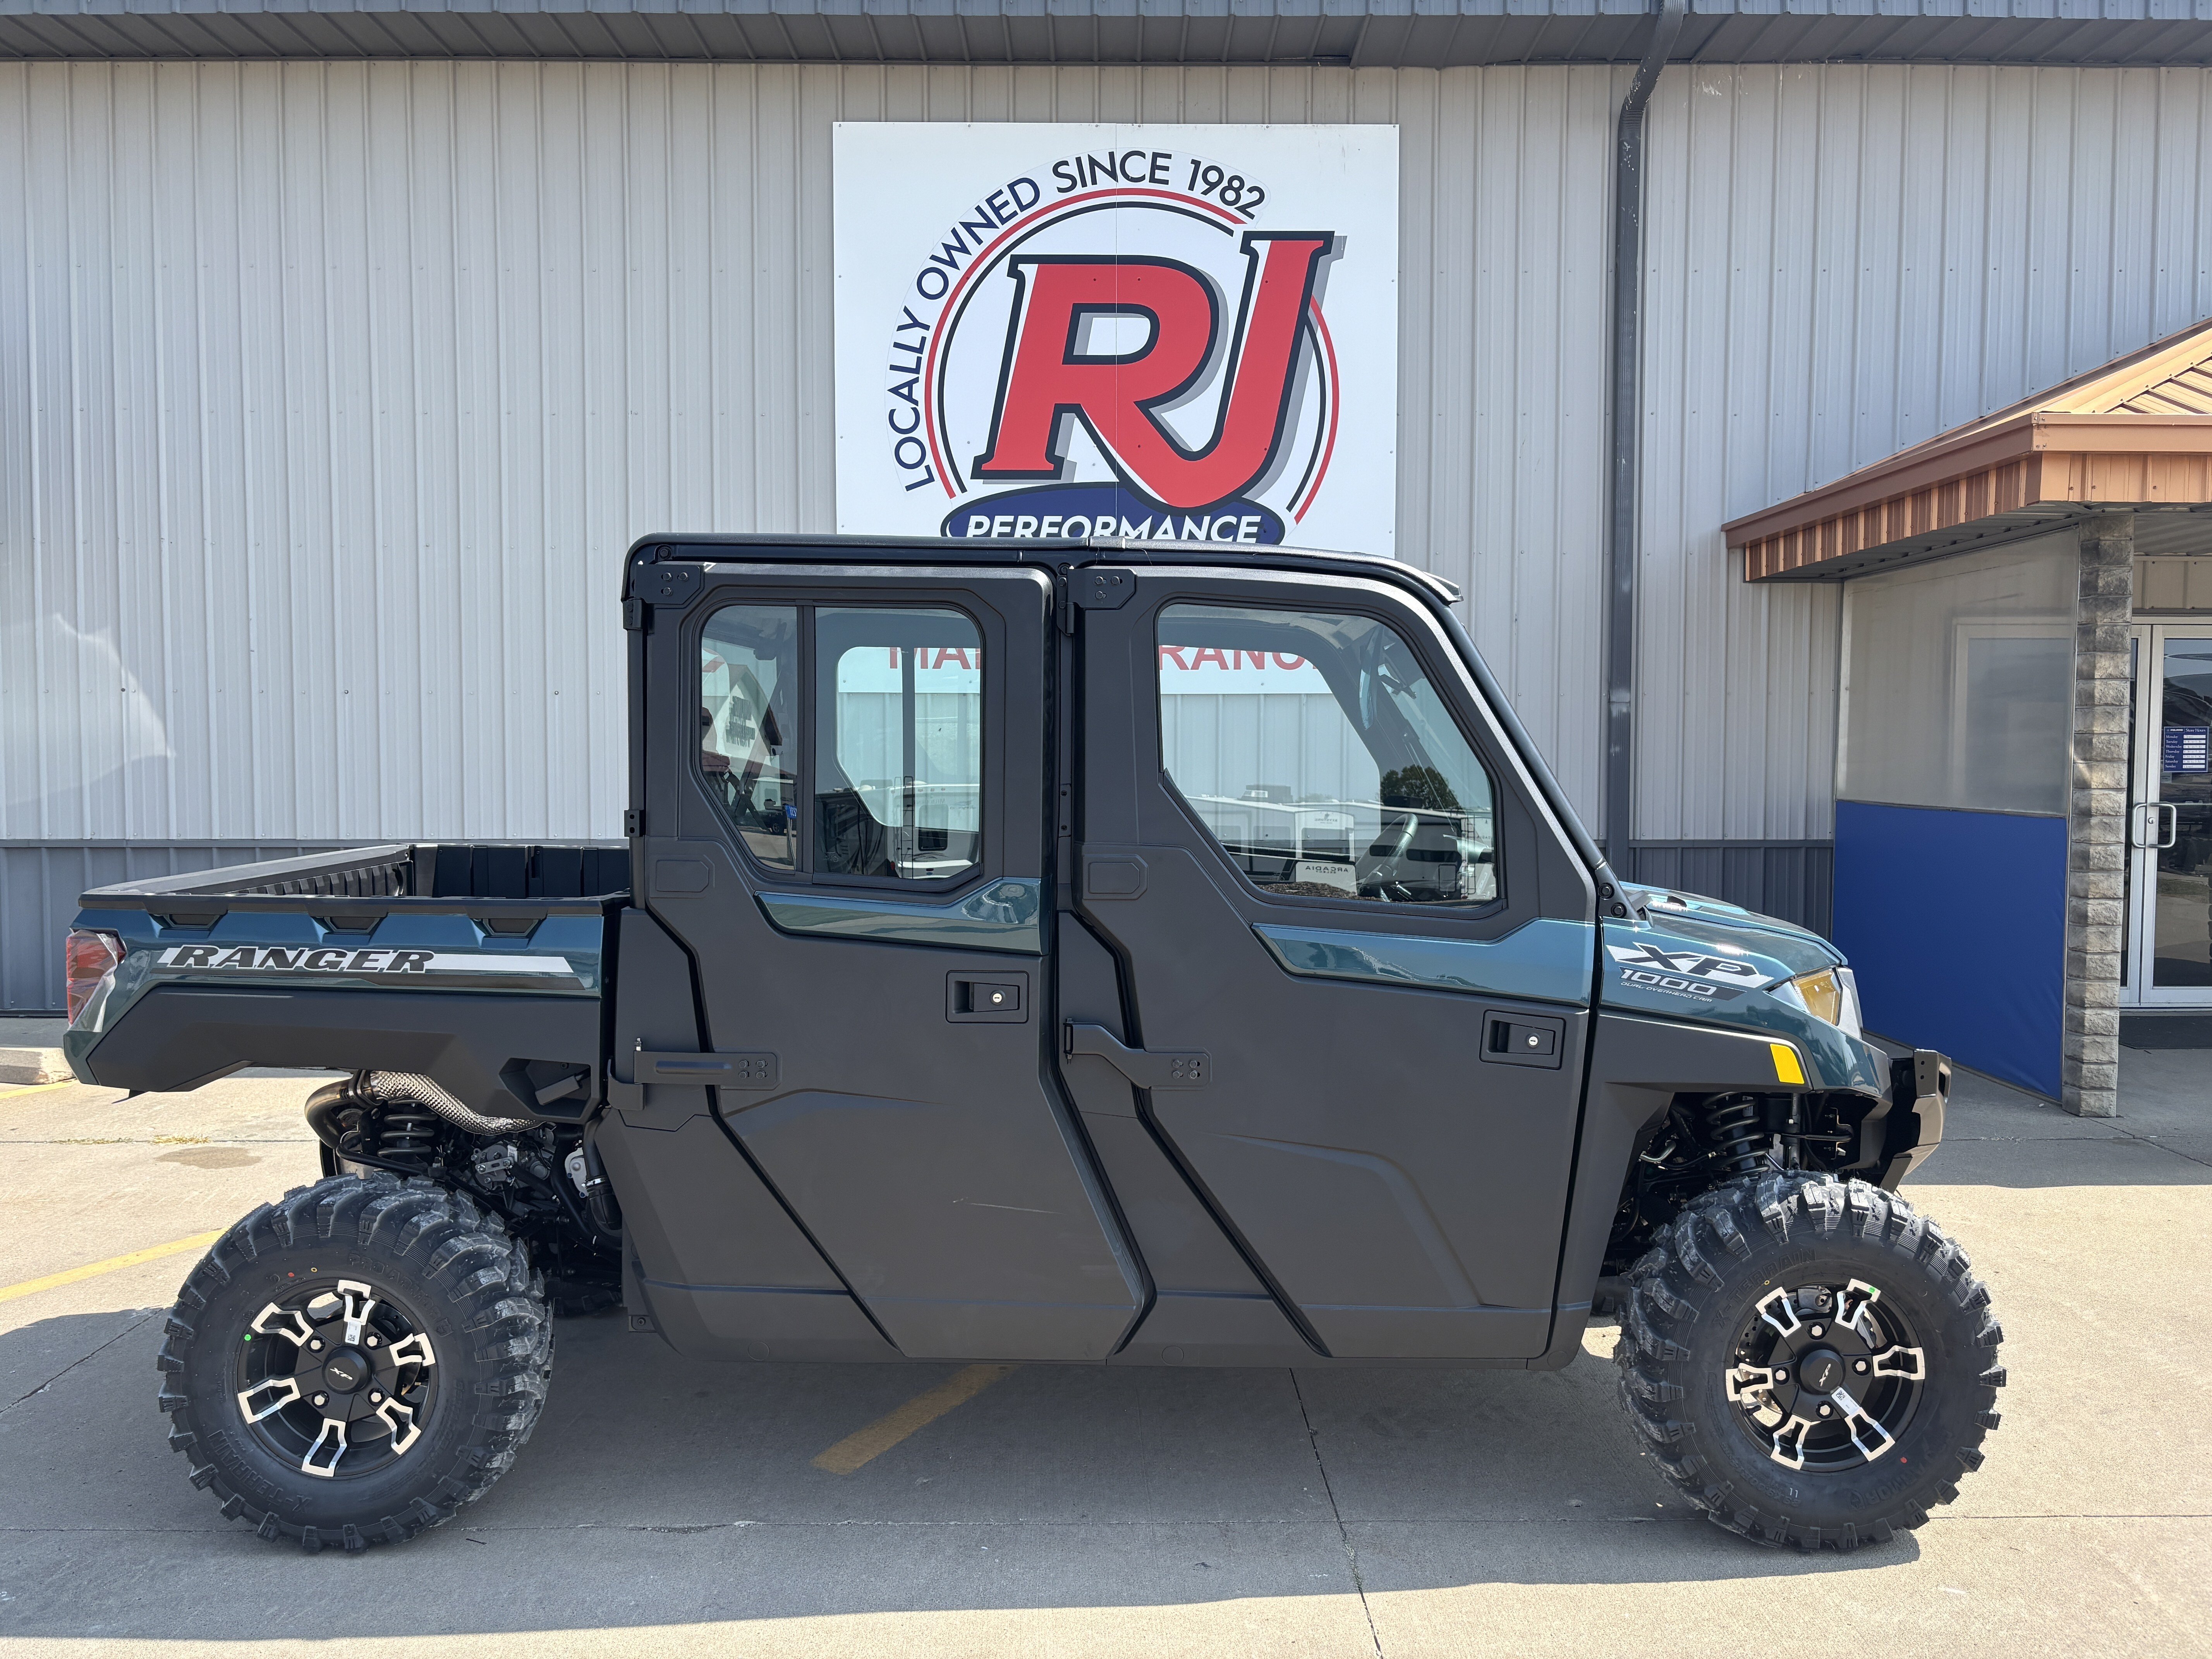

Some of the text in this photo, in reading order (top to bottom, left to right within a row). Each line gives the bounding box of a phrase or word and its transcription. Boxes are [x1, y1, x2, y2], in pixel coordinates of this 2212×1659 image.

[887, 151, 1266, 491] LOCALLY OWNED SINCE 1982
[970, 231, 1335, 515] RJ
[966, 515, 1261, 543] PERFORMANCE
[166, 945, 434, 974] RANGER
[1618, 943, 1759, 976] XP
[1620, 969, 1717, 996] 1000
[1620, 982, 1693, 999] DUAL-OVERHEAD
[330, 1367, 353, 1380] XP
